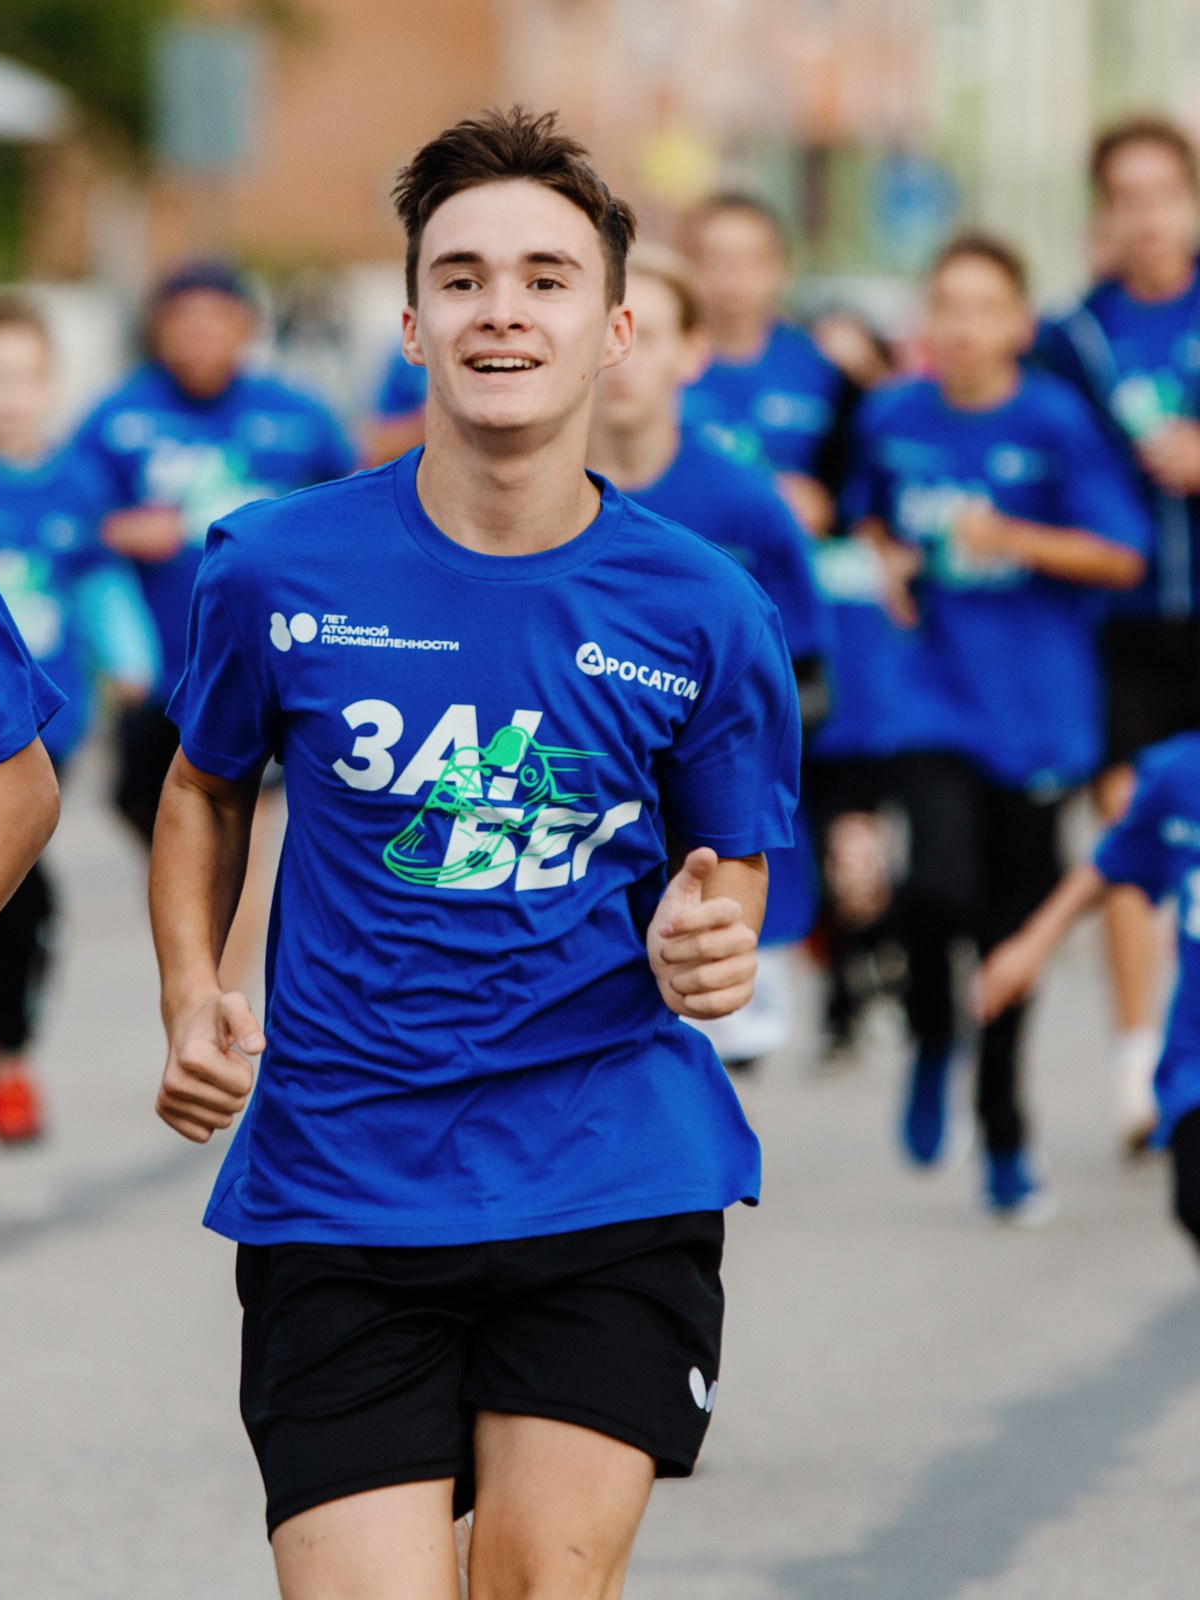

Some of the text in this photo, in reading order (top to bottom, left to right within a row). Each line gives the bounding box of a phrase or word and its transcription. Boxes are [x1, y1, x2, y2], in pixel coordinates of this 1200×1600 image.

[321, 614, 349, 625] ЛЕТ
[321, 624, 390, 637] АТОМНОЙ
[321, 635, 460, 651] ПРОМЫШЛЕННОСТИ
